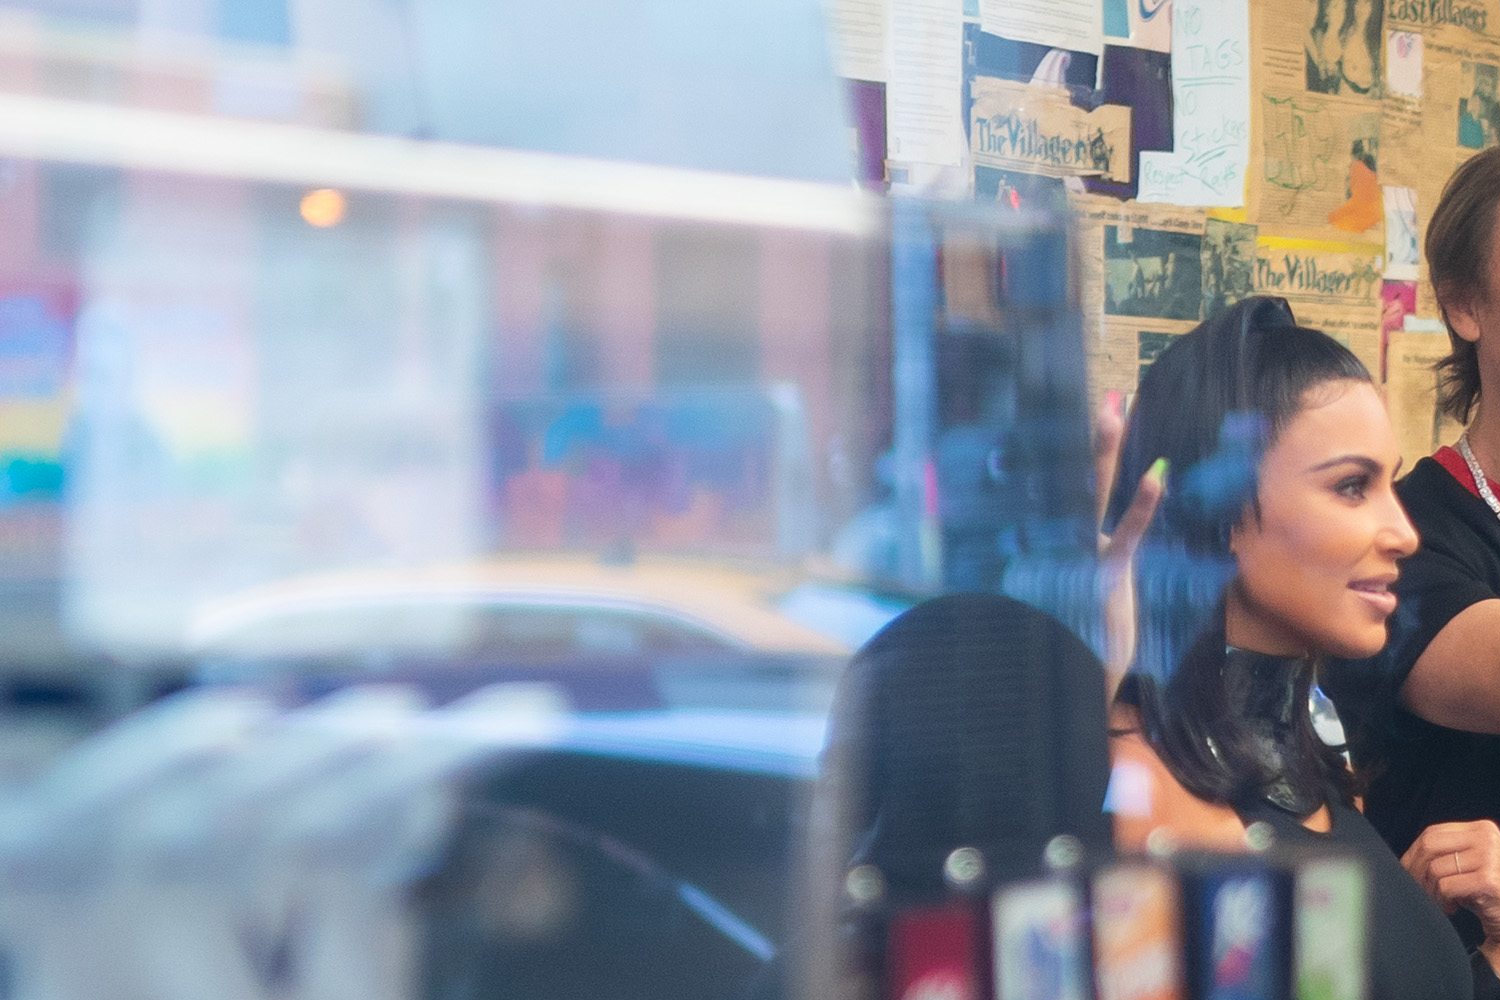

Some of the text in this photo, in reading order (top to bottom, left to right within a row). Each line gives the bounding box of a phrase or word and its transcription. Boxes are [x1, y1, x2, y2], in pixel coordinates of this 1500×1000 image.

[1186, 39, 1243, 73] TAGS
[1256, 253, 1357, 295] The Villager
